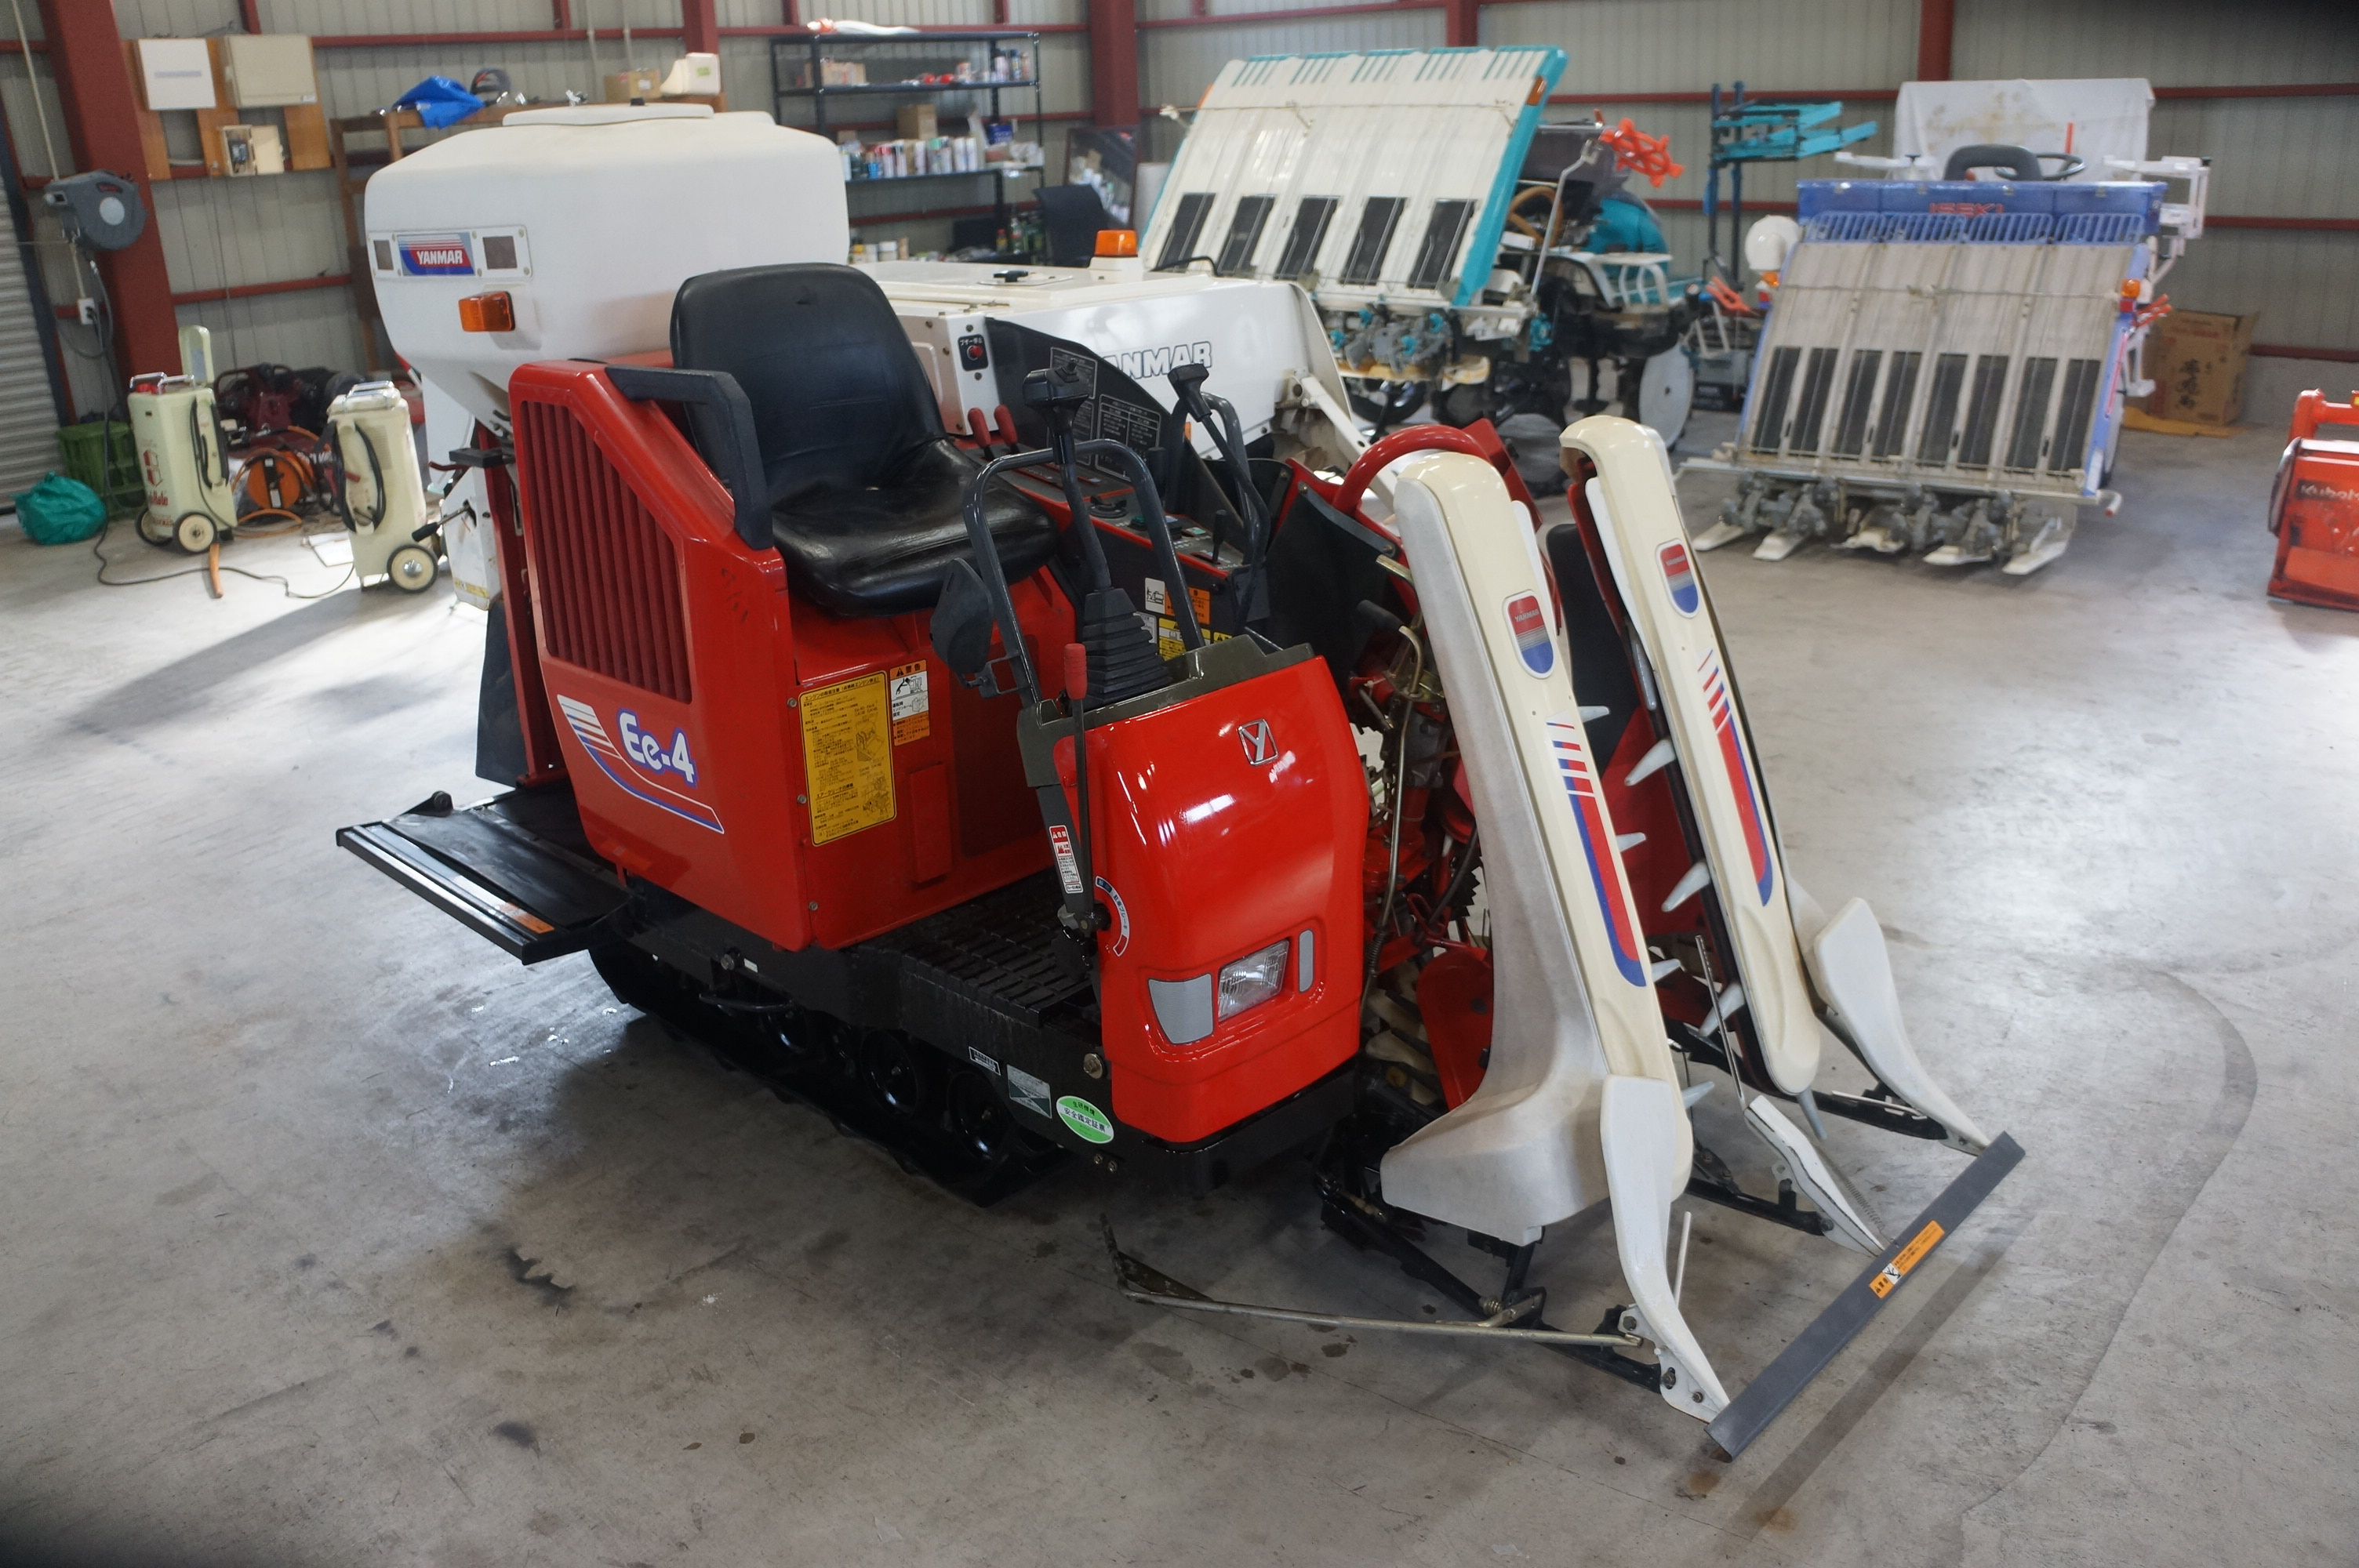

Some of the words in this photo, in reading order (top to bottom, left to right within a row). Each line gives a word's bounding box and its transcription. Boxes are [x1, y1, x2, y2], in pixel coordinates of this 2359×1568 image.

[416, 249, 463, 266] YANMAR
[1103, 340, 1212, 379] ANMAR
[1514, 608, 1540, 622] YANMAR
[618, 710, 696, 785] Ee-4
